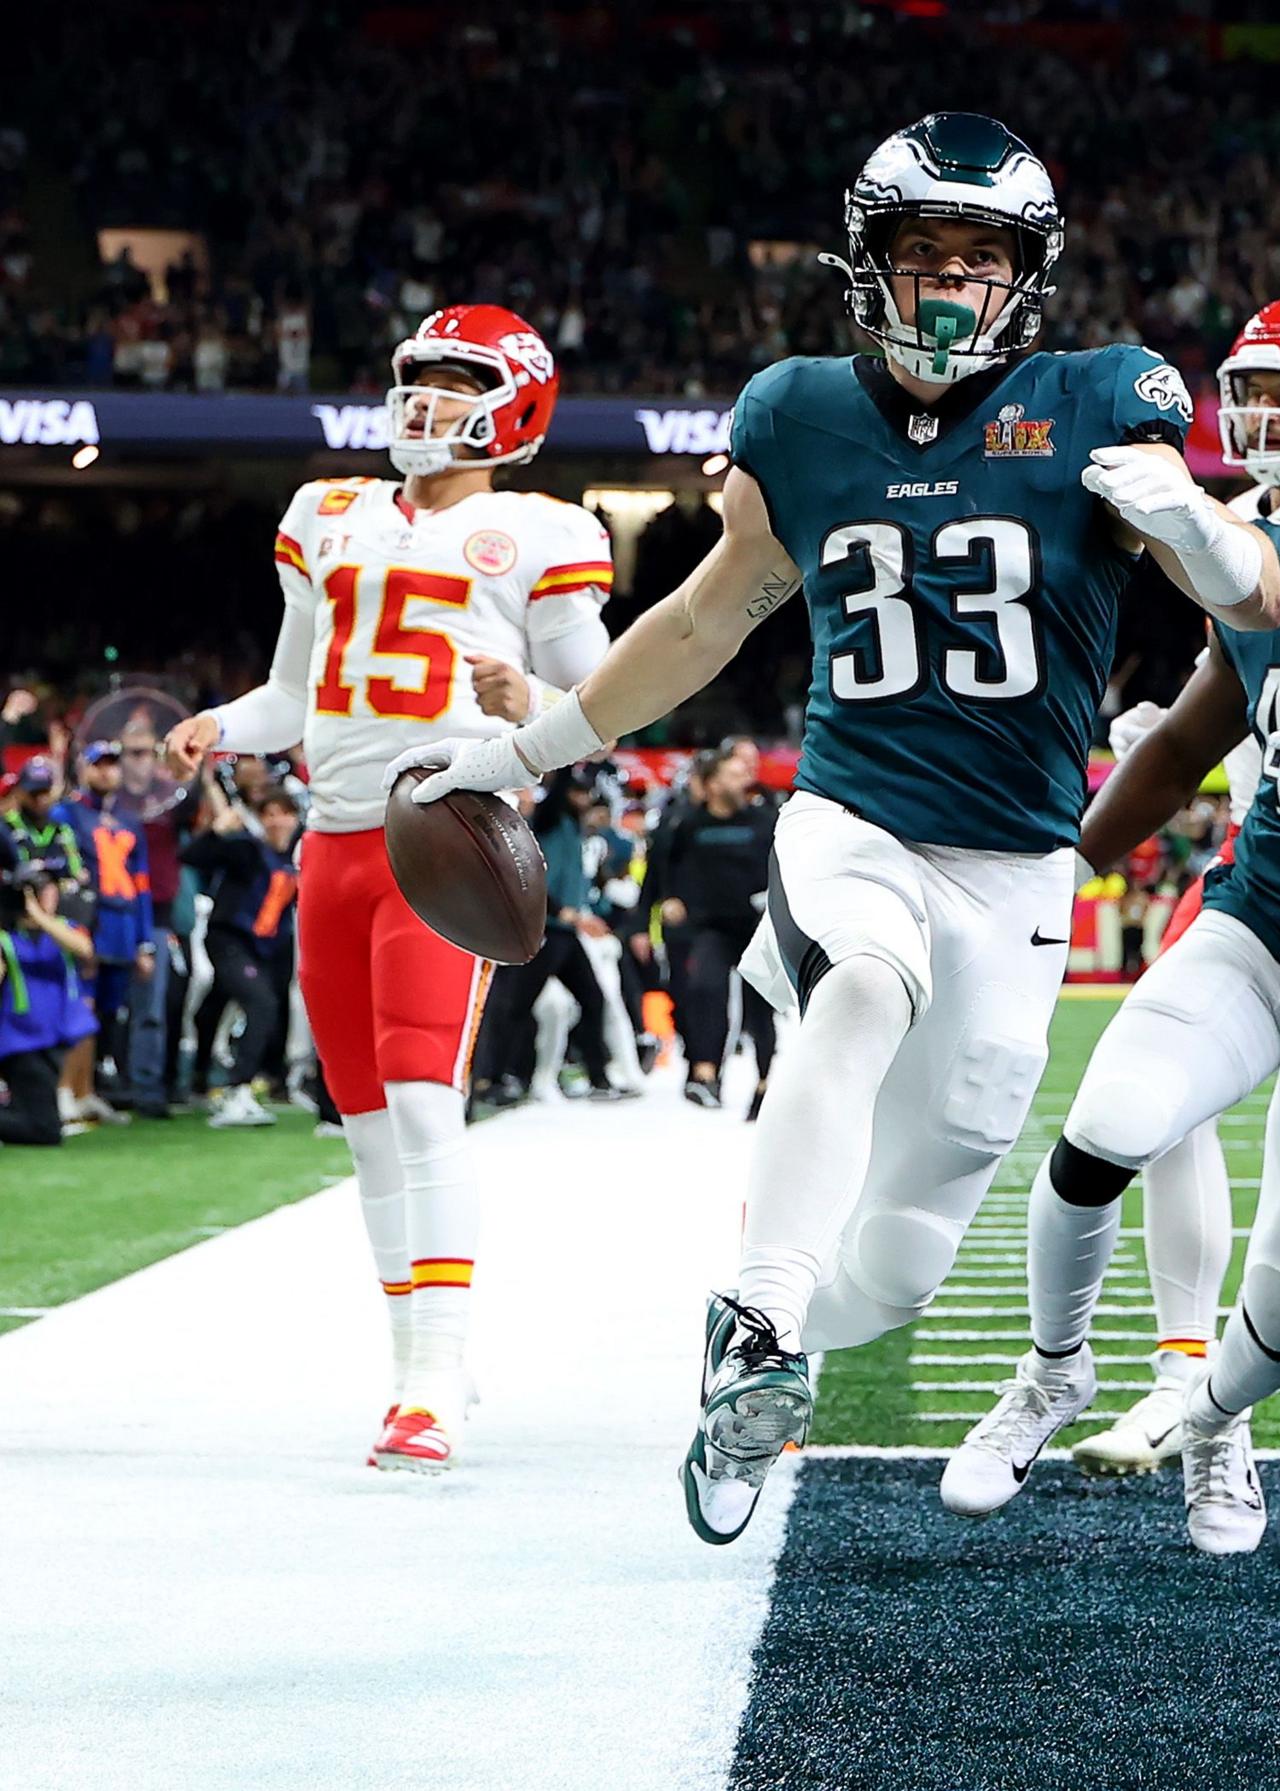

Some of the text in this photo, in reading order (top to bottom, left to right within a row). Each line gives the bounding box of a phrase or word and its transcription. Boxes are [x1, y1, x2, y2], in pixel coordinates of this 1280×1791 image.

[0, 399, 100, 445] VISA
[311, 405, 391, 450] VIS
[886, 481, 959, 499] EAGLES
[820, 516, 1041, 702] 33
[315, 564, 473, 724] 15
